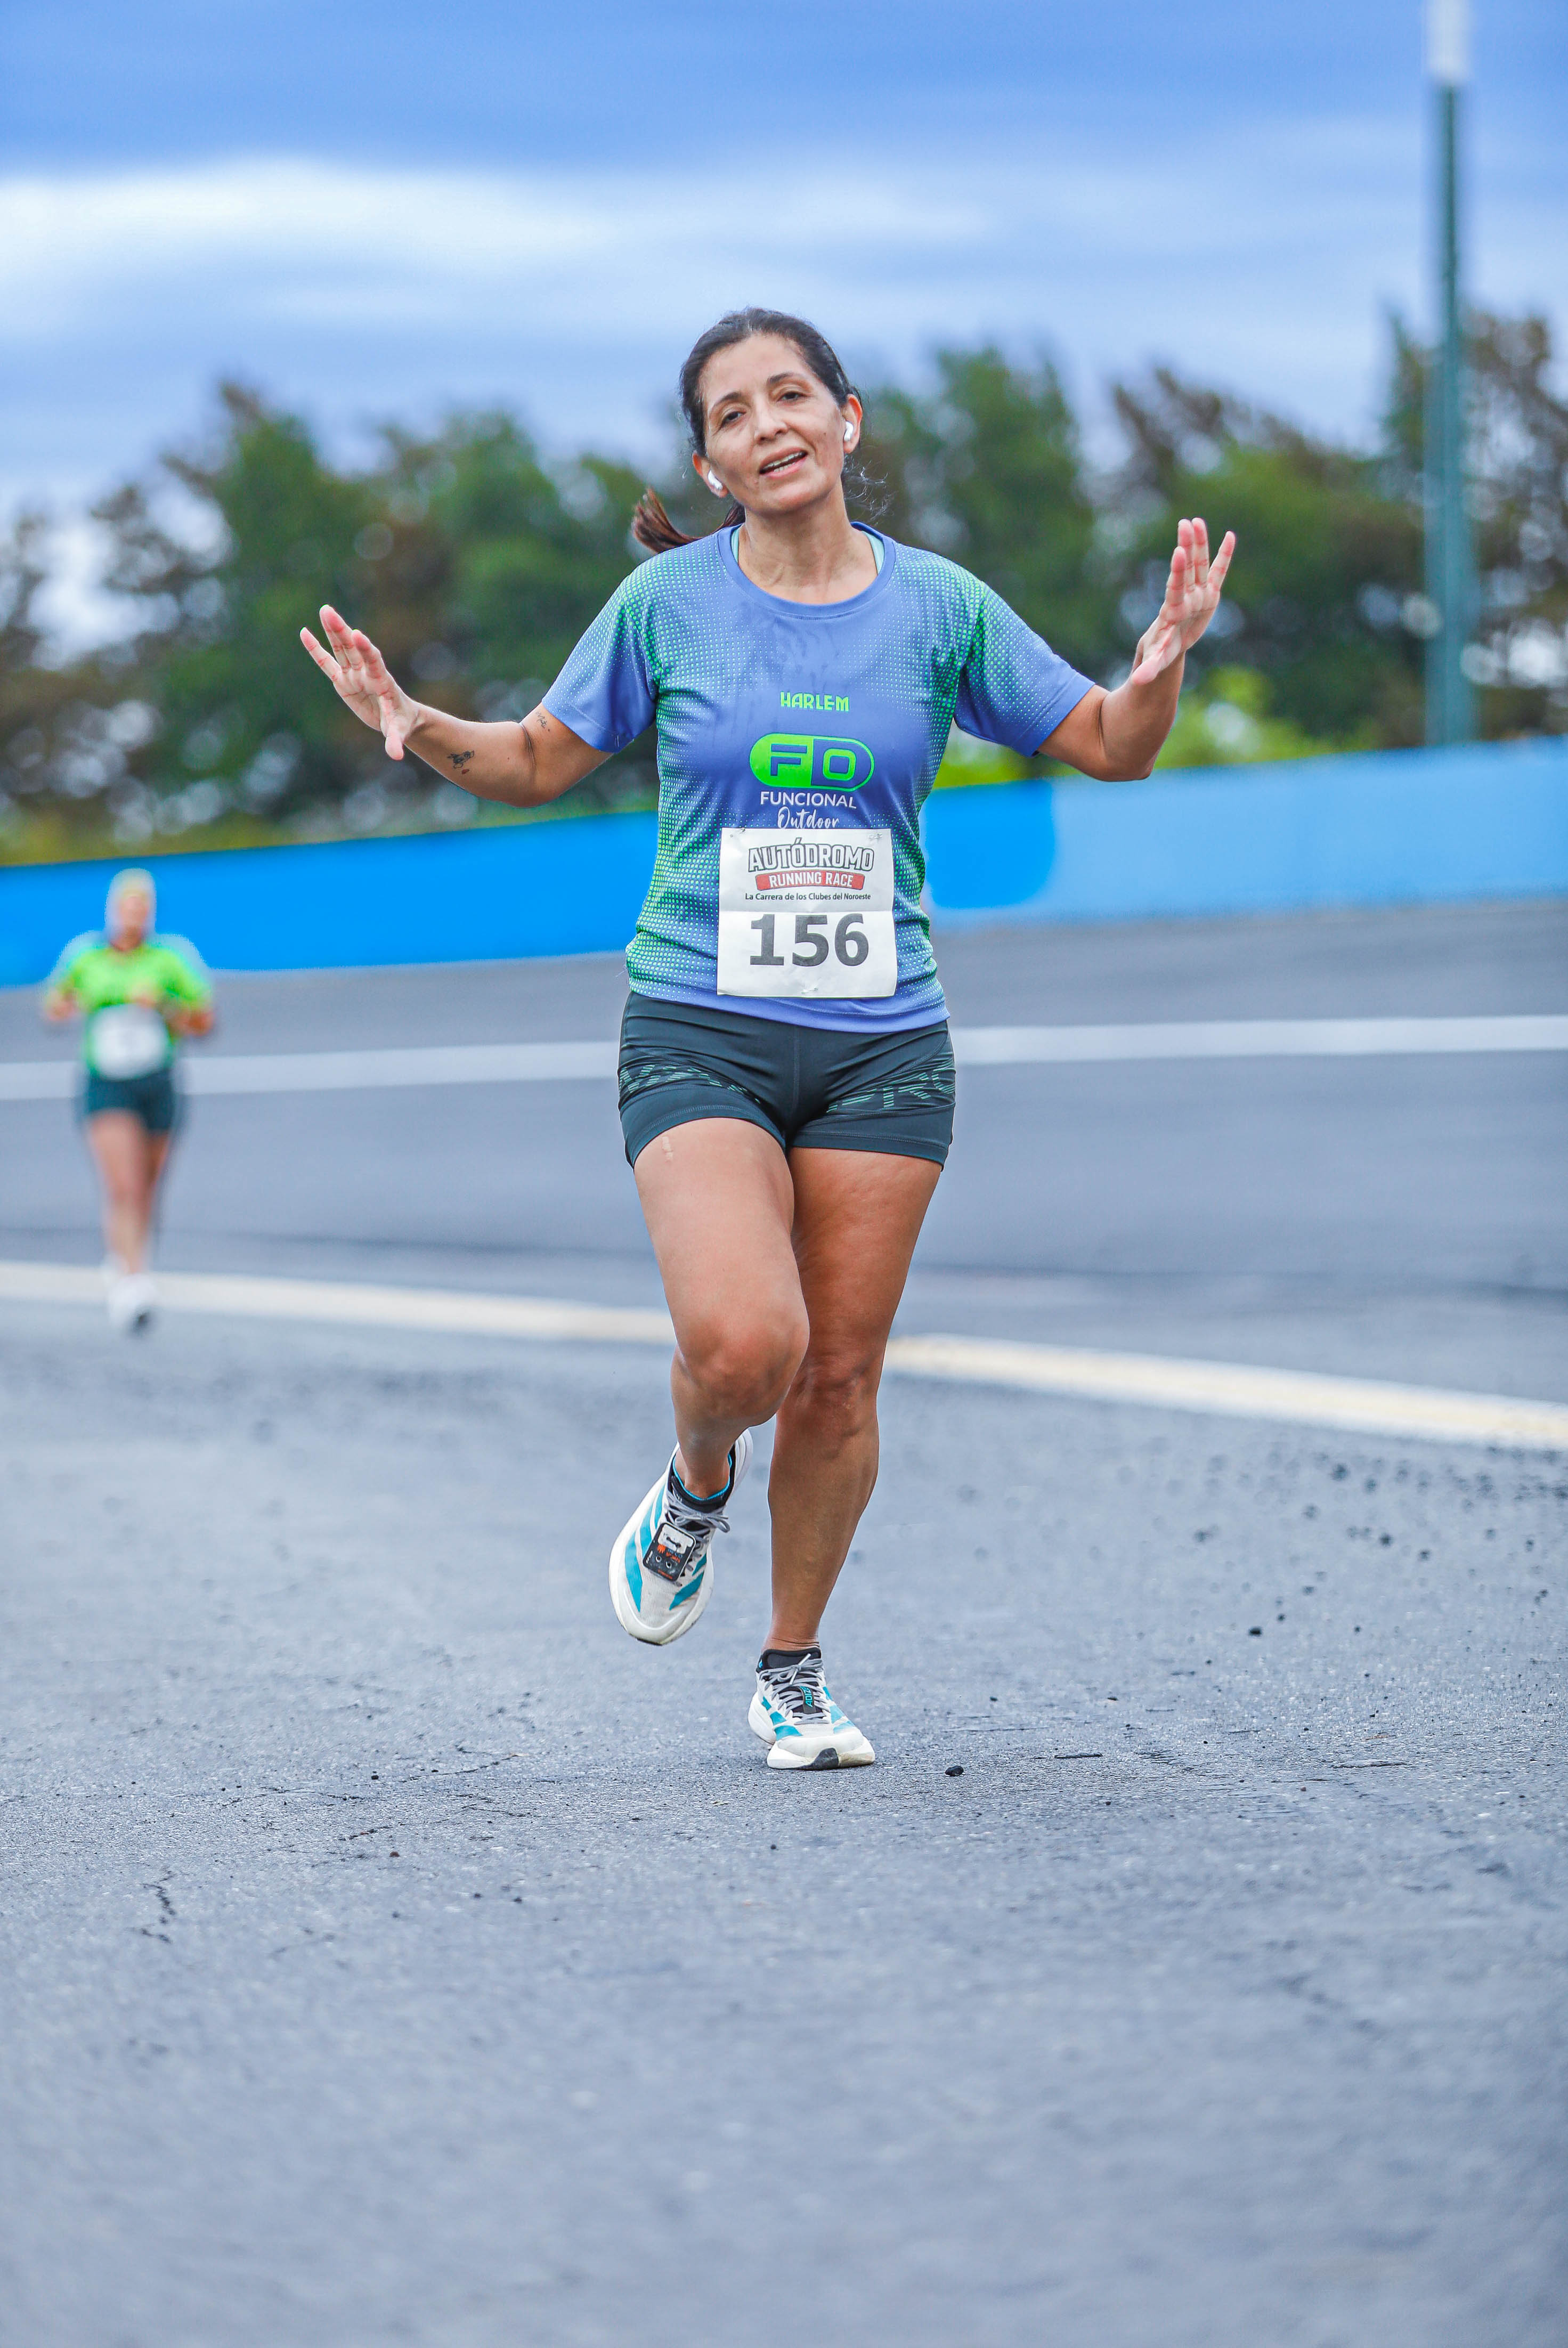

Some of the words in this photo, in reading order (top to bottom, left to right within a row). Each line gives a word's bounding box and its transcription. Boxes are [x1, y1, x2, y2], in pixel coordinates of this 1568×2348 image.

[780, 692, 849, 712] HARLEM
[760, 791, 857, 809] FUNCIONAL
[777, 806, 840, 829] Outdoor
[748, 837, 874, 872] AUTÓDROMO
[769, 872, 822, 888] RUNNING
[825, 872, 854, 888] RACE
[750, 913, 869, 967] 156
